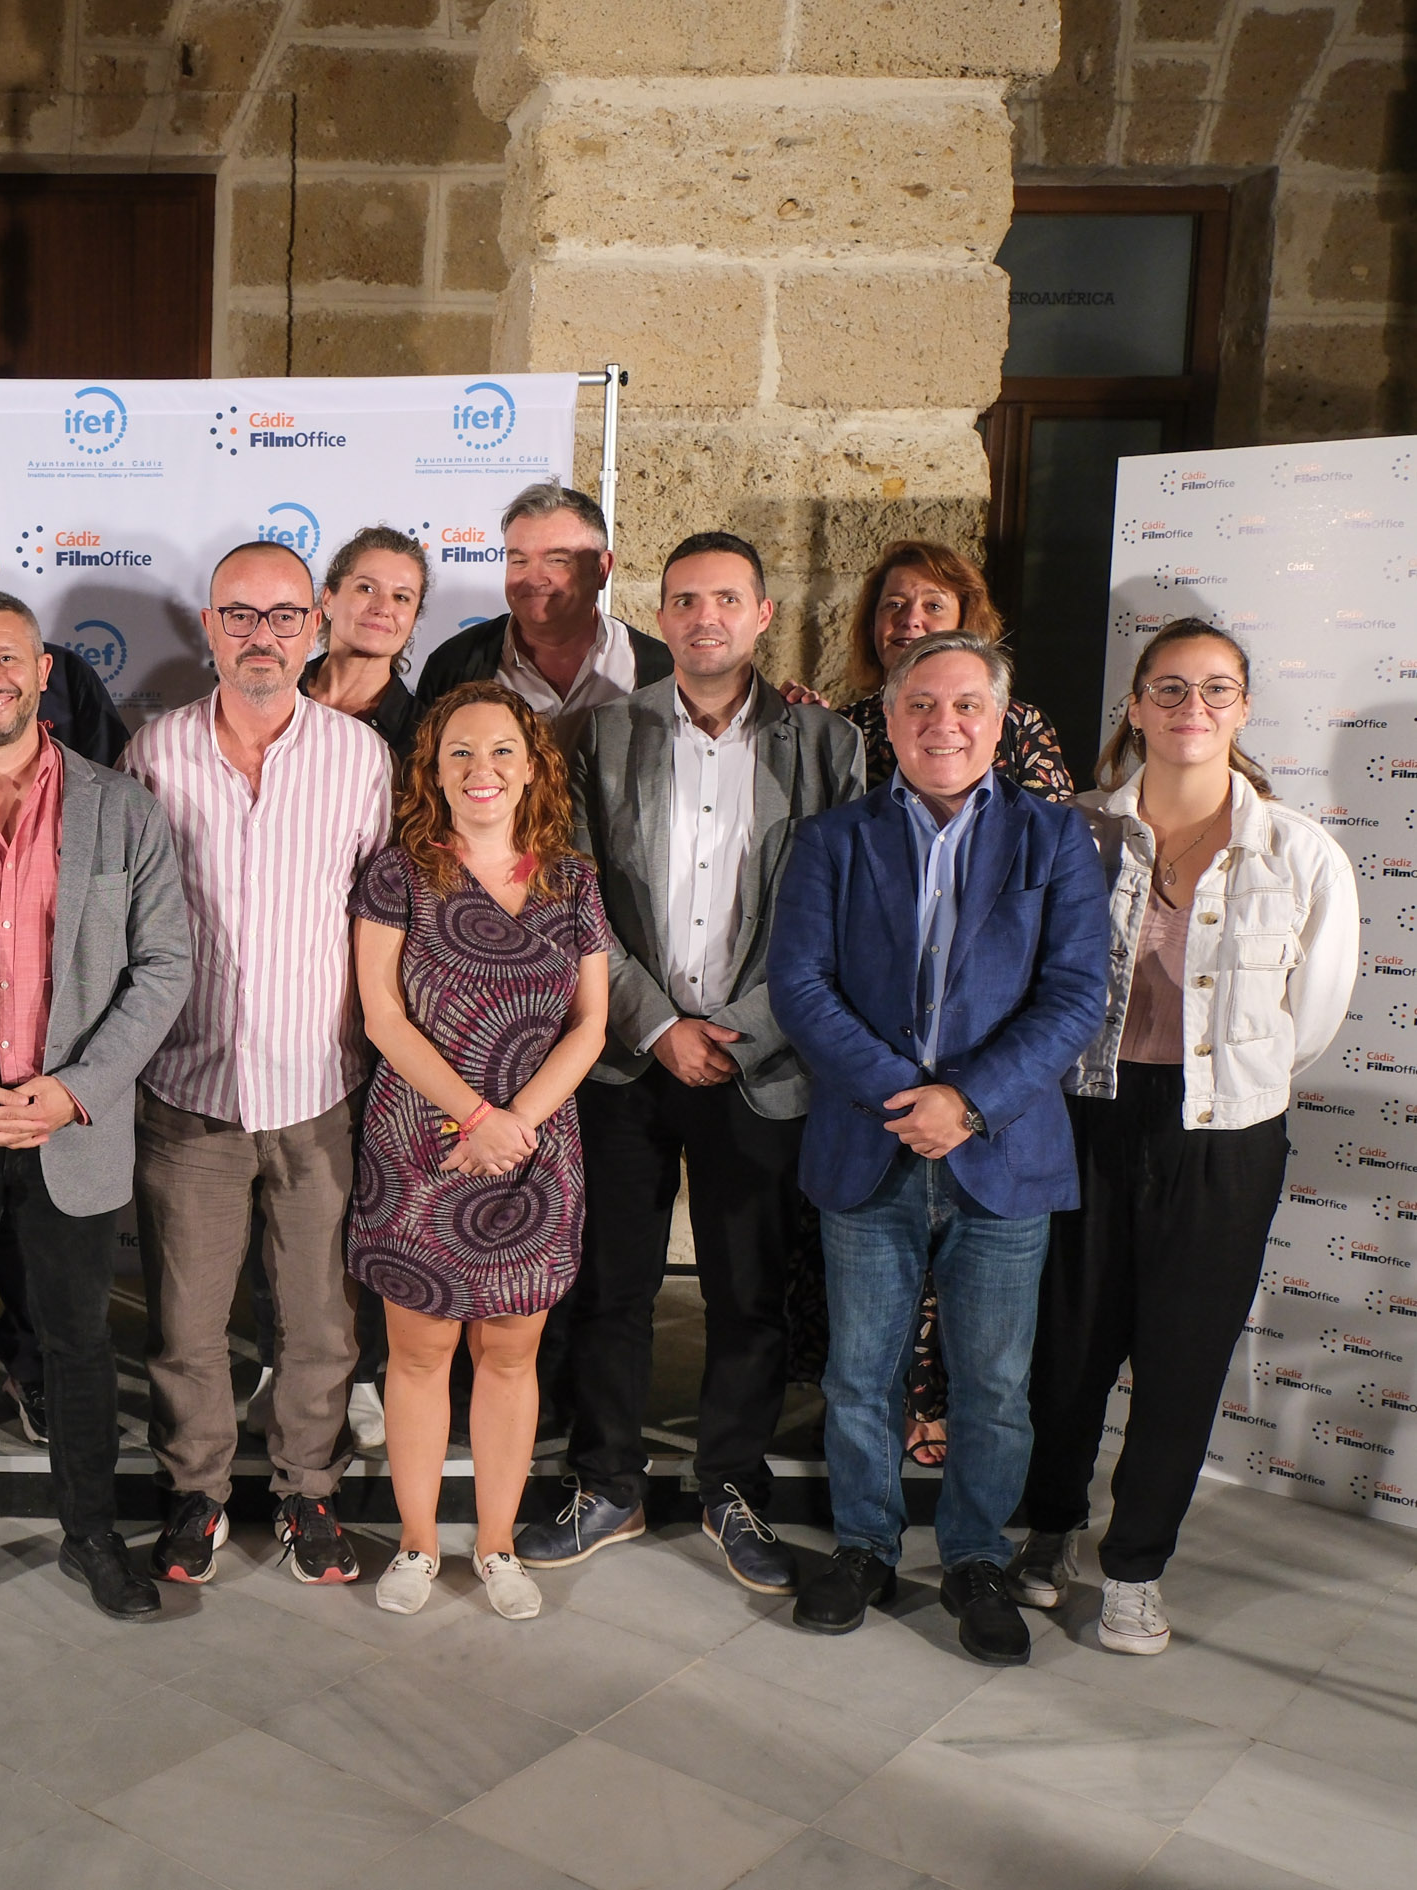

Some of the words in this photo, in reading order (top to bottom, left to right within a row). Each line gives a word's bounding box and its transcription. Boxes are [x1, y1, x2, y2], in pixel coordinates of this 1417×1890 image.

[64, 408, 116, 434] ifef
[249, 412, 295, 428] Cádiz
[453, 404, 504, 429] ifef
[249, 431, 347, 448] FilmOffice
[28, 459, 104, 468] Ayuntamiento
[111, 459, 124, 467] de
[131, 459, 162, 467] Cádiz
[415, 456, 491, 465] Ayuntamiento
[1181, 470, 1207, 481] Cádiz
[1294, 471, 1353, 484] FilmOffice
[1181, 479, 1235, 491] FilmOffice
[1142, 520, 1166, 531] Cádiz
[54, 531, 101, 546] Cádiz
[441, 527, 486, 543] Cádiz
[1141, 529, 1194, 540] FilmOffice
[55, 551, 152, 567] FilmOffice
[1175, 566, 1200, 576] Cádiz
[1175, 575, 1228, 586] FilmOffice
[1135, 614, 1160, 623] Cádiz
[1328, 718, 1388, 729] FilmOffice
[1271, 756, 1298, 767] Cádiz
[1270, 766, 1330, 778] FilmOffice
[1320, 805, 1349, 816] Cádiz
[1320, 816, 1380, 828] FilmOffice
[1383, 857, 1413, 868] Cádiz
[1374, 955, 1405, 966] Cádiz
[1366, 1051, 1396, 1063] Cádiz
[1297, 1091, 1325, 1102] Cádiz
[1297, 1101, 1356, 1117] FilmOffice
[1358, 1146, 1388, 1158] Cádiz
[1358, 1157, 1417, 1173] FilmOffice
[1290, 1184, 1318, 1196] Cádiz
[1290, 1194, 1348, 1211] FilmOffice
[1351, 1240, 1380, 1253] Cádiz
[1351, 1251, 1412, 1269] FilmOffice
[1283, 1276, 1310, 1288] Cádiz
[1283, 1286, 1341, 1304] FilmOffice
[1343, 1333, 1372, 1347] Cádiz
[1343, 1343, 1403, 1363] FilmOffice
[1275, 1366, 1303, 1380] Cádiz
[1275, 1377, 1333, 1396] FilmOffice
[1382, 1389, 1411, 1402] Cádiz
[1222, 1400, 1249, 1414] Cádiz
[1222, 1410, 1278, 1430] FilmOffice
[1336, 1425, 1364, 1440] Cádiz
[1336, 1436, 1395, 1456] FilmOffice
[1268, 1456, 1296, 1470] Cádiz
[1268, 1466, 1326, 1487] FilmOffice
[1374, 1480, 1403, 1495] Cádiz
